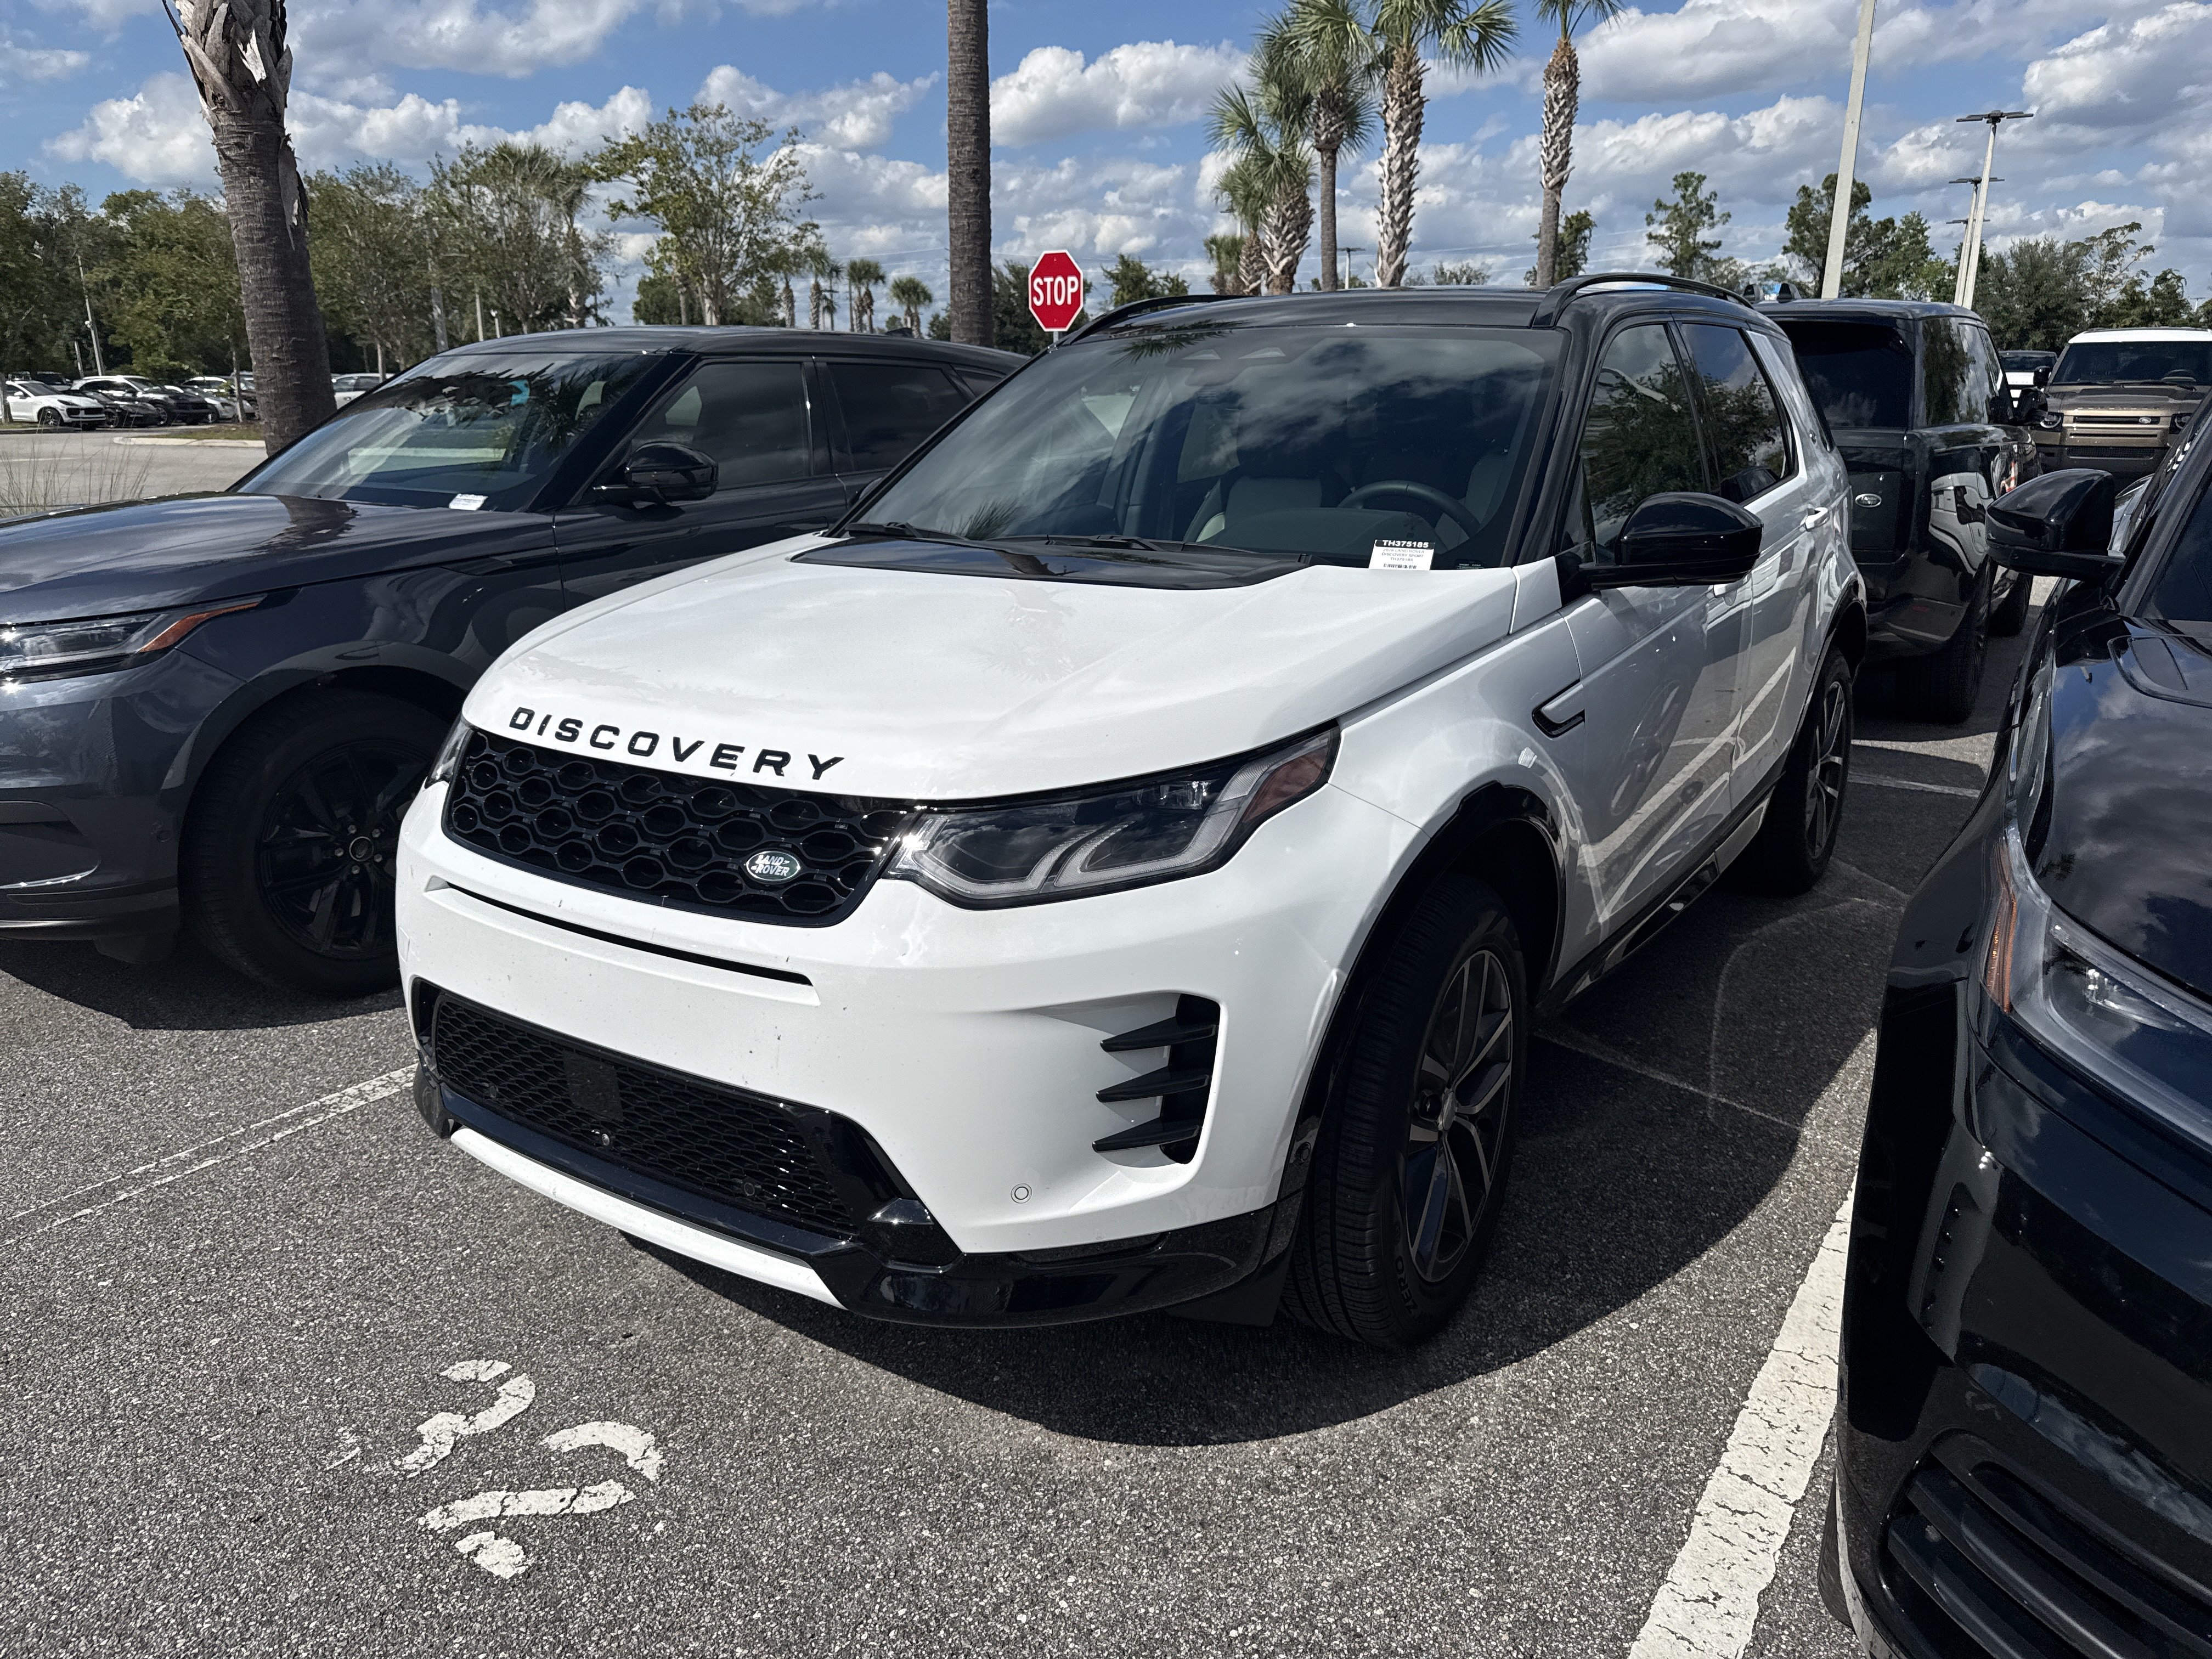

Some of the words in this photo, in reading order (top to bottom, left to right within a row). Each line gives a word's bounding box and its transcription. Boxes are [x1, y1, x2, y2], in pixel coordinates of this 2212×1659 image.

[1032, 275, 1079, 306] STOP
[1382, 539, 1429, 548] TH375185
[509, 707, 845, 781] DISCOVERY
[755, 855, 785, 866] LAND
[755, 863, 790, 877] ROVER
